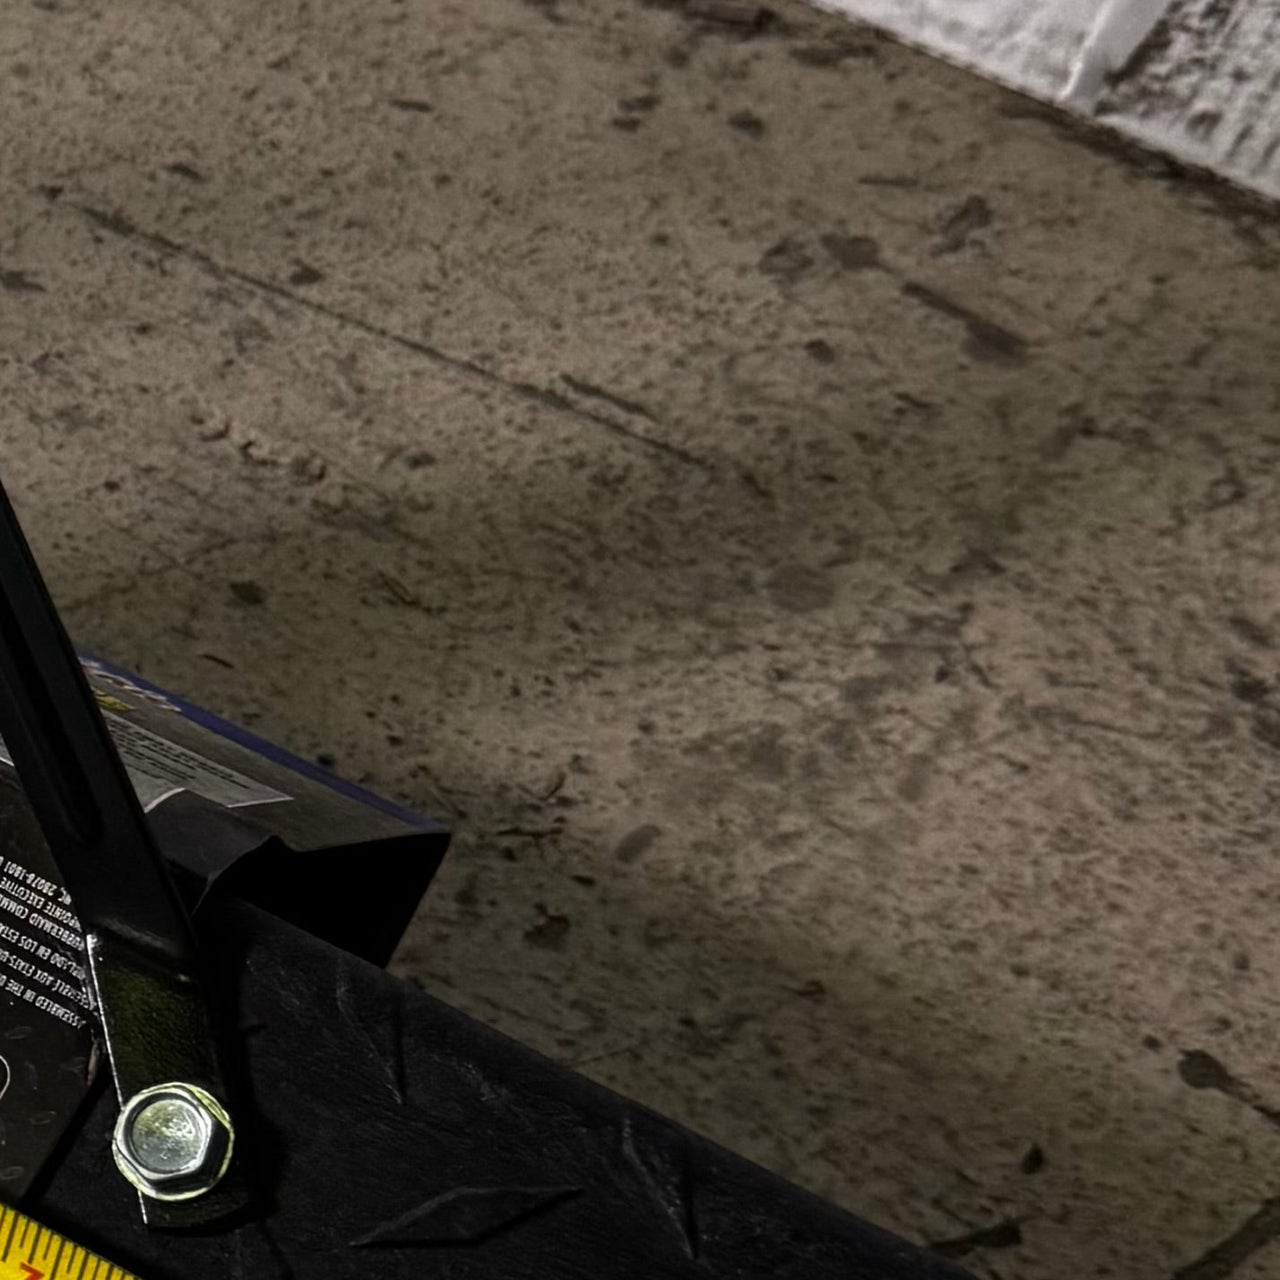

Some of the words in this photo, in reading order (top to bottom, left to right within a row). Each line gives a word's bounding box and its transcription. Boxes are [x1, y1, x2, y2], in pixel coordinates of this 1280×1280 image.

[17, 935, 36, 952] LOS
[35, 944, 50, 959] EN
[33, 968, 53, 985] AUX
[5, 979, 24, 995] THE
[23, 988, 35, 1001] IN
